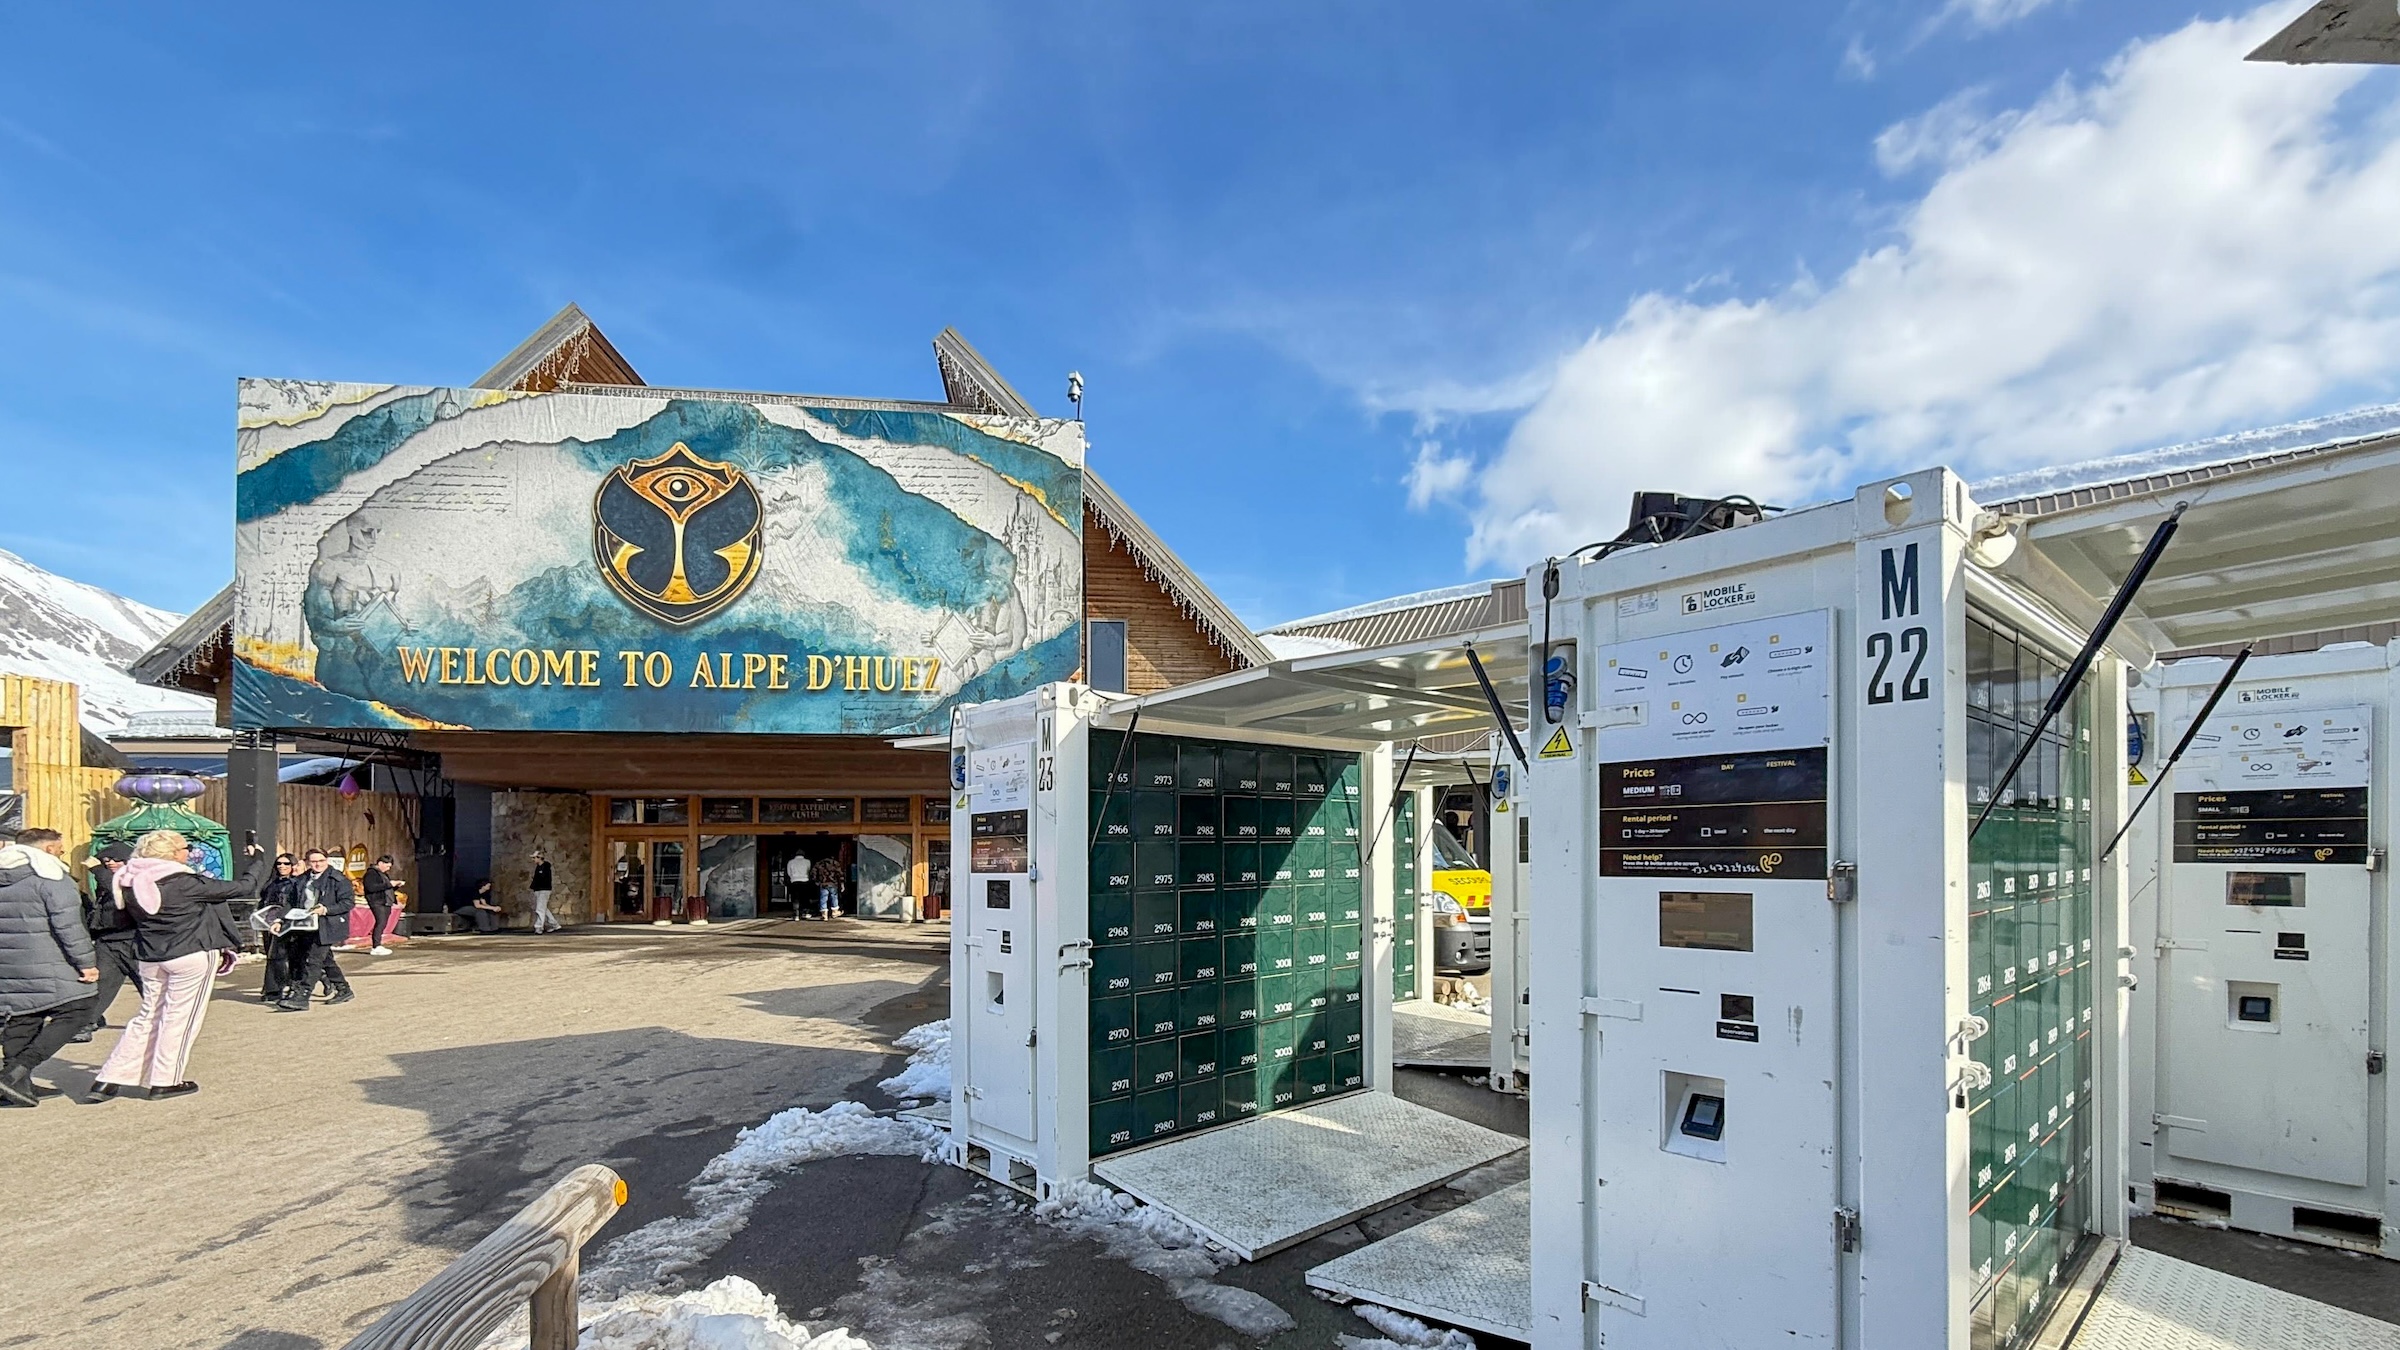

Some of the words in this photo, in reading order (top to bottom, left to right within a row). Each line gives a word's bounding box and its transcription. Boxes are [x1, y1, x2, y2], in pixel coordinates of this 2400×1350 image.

[1881, 542, 1919, 620] M
[1704, 584, 1743, 598] MOBILE
[397, 646, 600, 686] WELCOME
[619, 651, 673, 688] TO
[689, 652, 789, 690] ALPE
[1867, 627, 1928, 705] 22
[2256, 687, 2291, 695] MOBILE
[1042, 717, 1052, 752] M
[1766, 759, 1796, 768] FESTIVAL
[1039, 757, 1053, 791] 23
[1108, 773, 1128, 783] 265
[1623, 768, 1655, 778] Prices
[1154, 775, 1172, 785] 2973
[1198, 778, 1213, 787] 2981
[1240, 780, 1256, 789] 2989
[1276, 783, 1291, 791] 2997
[1623, 786, 1655, 795] MEDIUM
[2198, 795, 2227, 803] Prices
[769, 803, 797, 811] VISITOR
[792, 811, 820, 819] CENTER
[1622, 815, 1646, 823] Rental
[1647, 814, 1672, 825] period
[1108, 825, 1128, 834] 2966
[1155, 825, 1172, 834] 2974
[1197, 826, 1214, 835] 2982
[1239, 826, 1256, 835] 2990
[1276, 827, 1291, 835] 2998
[1110, 875, 1129, 885] 2967
[1155, 875, 1172, 884] 2975
[1197, 873, 1214, 882] 2983
[1242, 872, 1256, 881] 2991
[1155, 924, 1172, 933] 2976
[1197, 921, 1214, 930] 2984
[1108, 927, 1128, 937] 2968
[1241, 963, 1257, 972] 2993
[1155, 972, 1173, 982] 2977
[1197, 968, 1214, 978] 2985
[1109, 978, 1129, 988] 2969
[1240, 1009, 1256, 1019] 2994
[1198, 1015, 1215, 1025] 2986
[1155, 1021, 1173, 1032] 2978
[1109, 1028, 1129, 1040] 2970
[1720, 1028, 1755, 1037] Reservations
[1241, 1054, 1257, 1065] 2995
[1198, 1063, 1215, 1074] 2987
[1156, 1071, 1173, 1083] 2979
[1112, 1079, 1129, 1091] 2971
[1241, 1102, 1257, 1112] 2996
[1198, 1110, 1215, 1122] 2988
[1155, 1120, 1174, 1133] 2980
[1111, 1131, 1129, 1143] 2972
